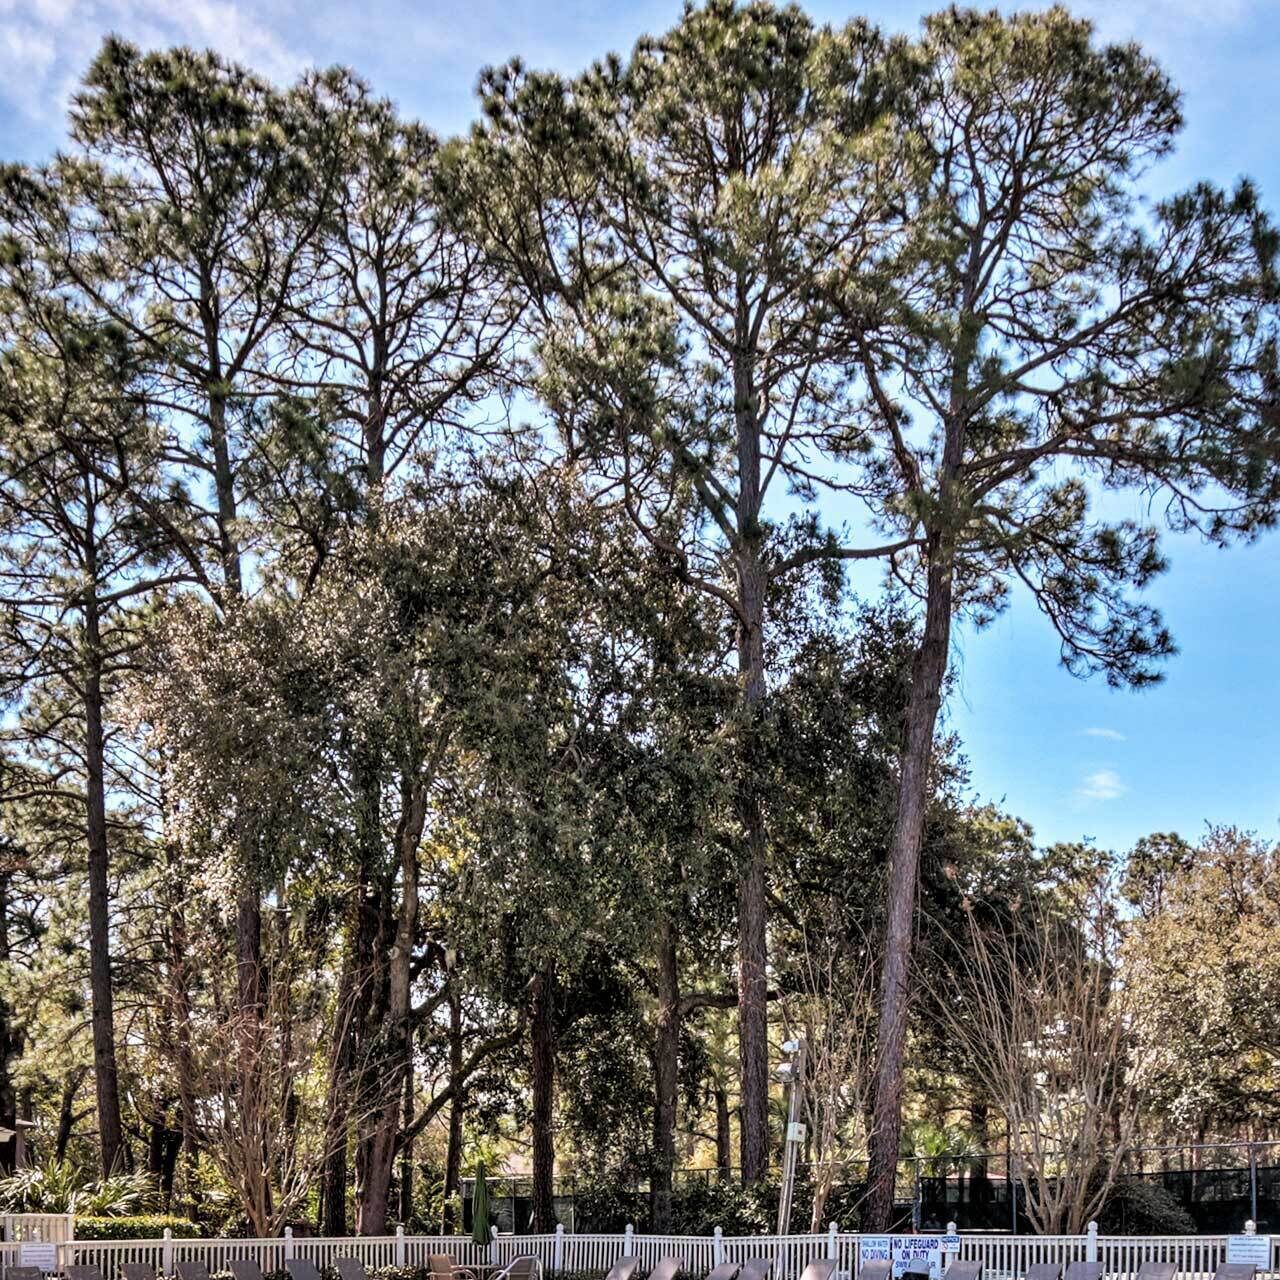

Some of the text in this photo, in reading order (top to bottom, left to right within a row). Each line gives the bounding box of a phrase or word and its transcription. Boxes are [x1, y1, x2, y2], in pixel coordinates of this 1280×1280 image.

[893, 1239, 903, 1249] NO
[904, 1239, 939, 1249] LIFEGUARD
[861, 1249, 888, 1260] NO DIVING
[901, 1250, 930, 1260] ON DUTY
